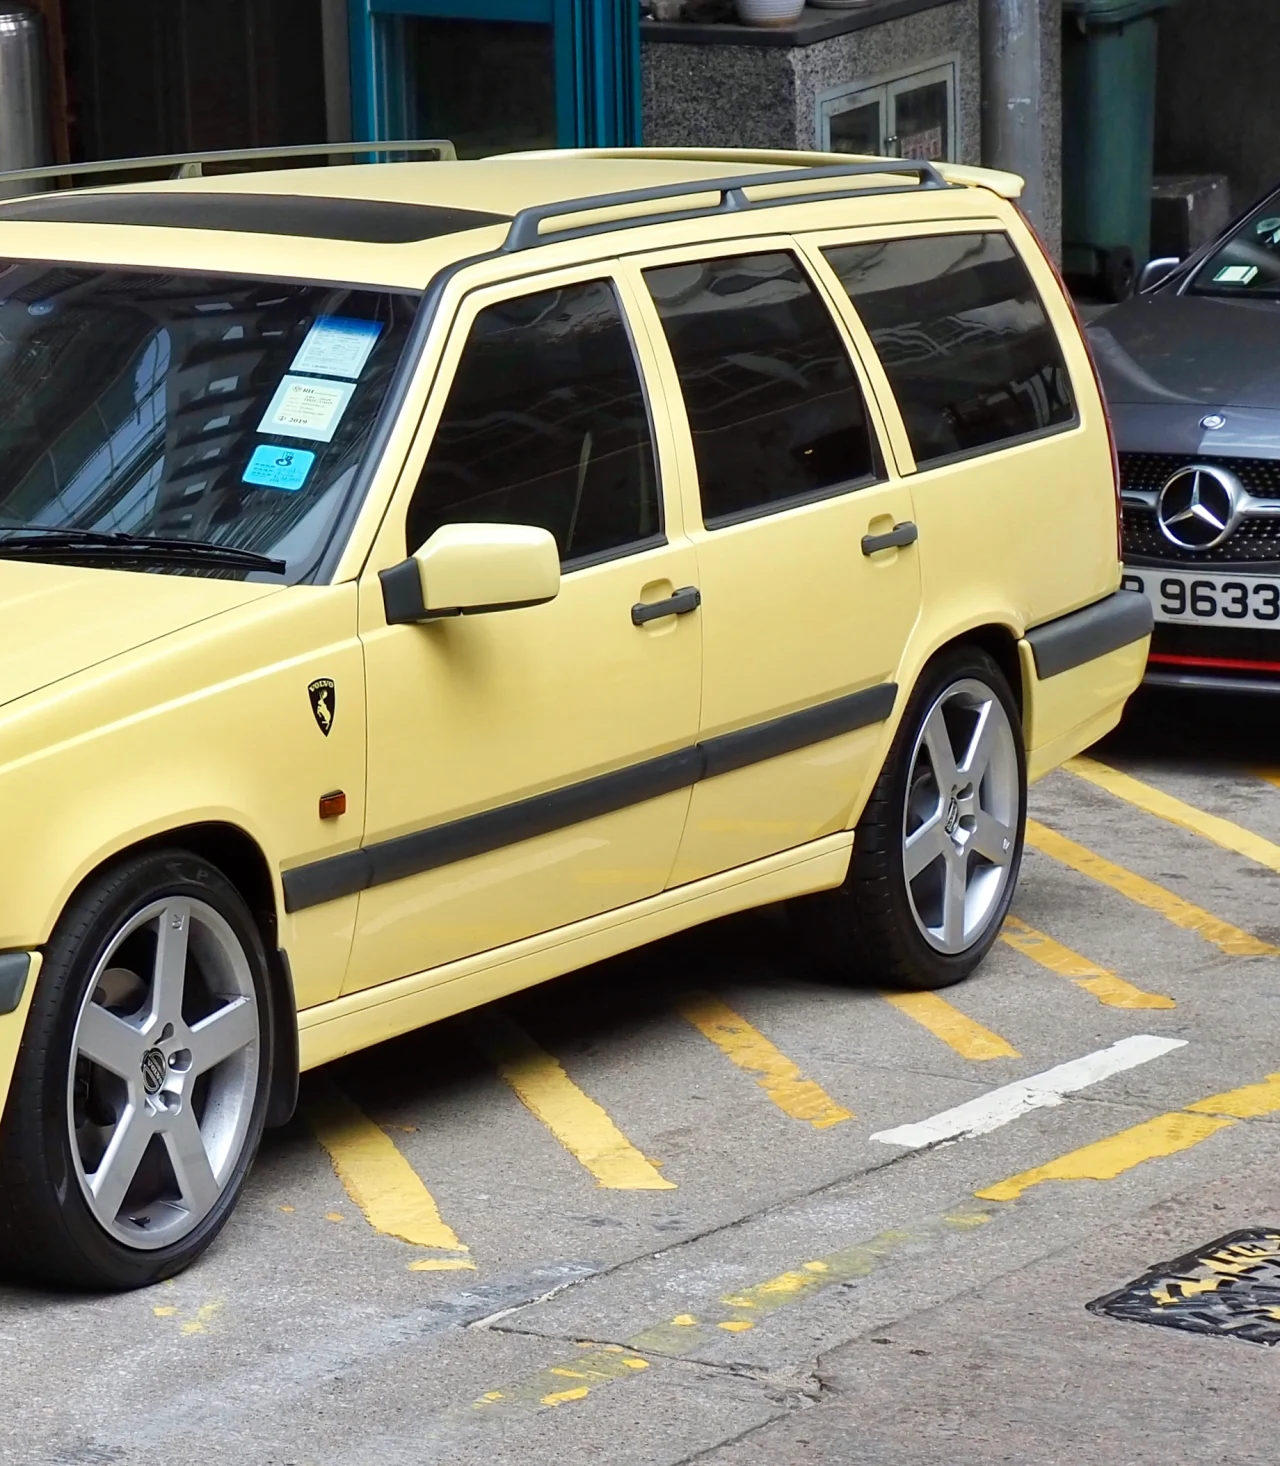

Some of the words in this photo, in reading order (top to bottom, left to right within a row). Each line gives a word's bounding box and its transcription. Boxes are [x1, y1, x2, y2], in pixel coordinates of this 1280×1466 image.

[1160, 578, 1280, 621] 9633
[309, 680, 334, 692] VOLVO
[147, 1058, 163, 1085] VOLVO
